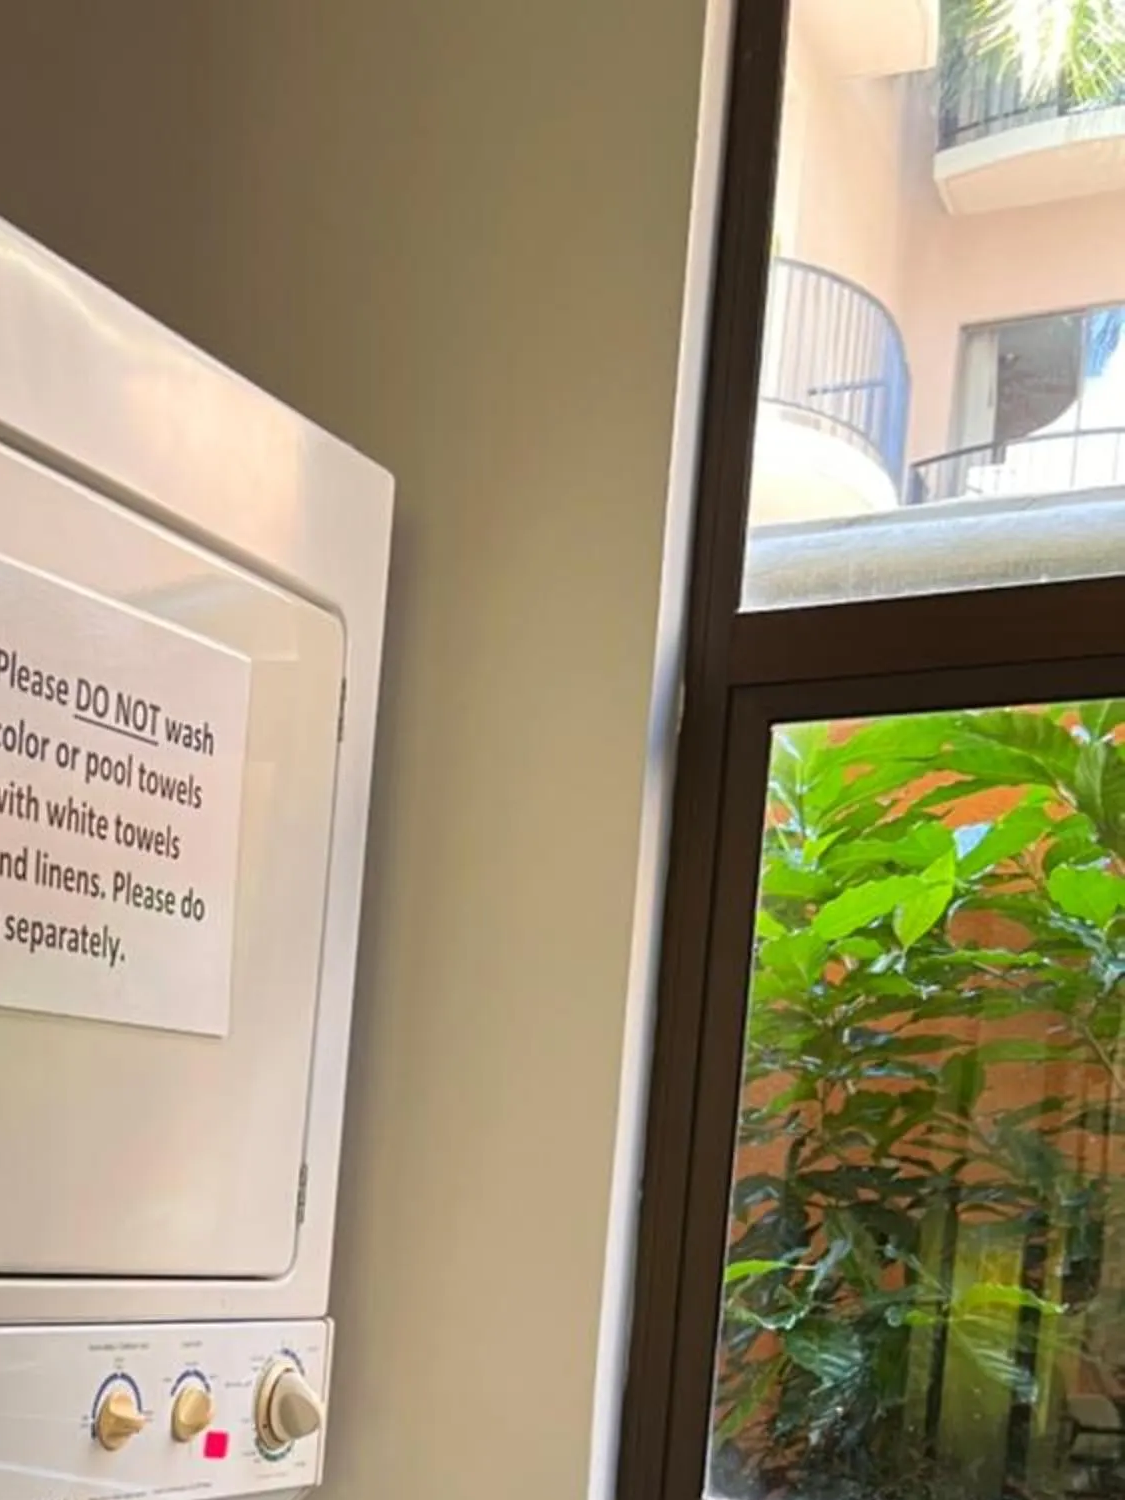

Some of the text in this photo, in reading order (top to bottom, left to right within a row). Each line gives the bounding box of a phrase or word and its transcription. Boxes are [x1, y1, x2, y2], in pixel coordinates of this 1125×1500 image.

[75, 677, 110, 719] DO
[114, 691, 161, 737] NOT
[165, 716, 214, 757] wash
[56, 741, 80, 770] or
[84, 750, 133, 789] pool
[138, 761, 203, 809] towels
[46, 796, 109, 841] white
[115, 813, 181, 861] towels
[34, 848, 106, 900] linens.
[112, 869, 176, 916] Please
[181, 887, 206, 922] do
[4, 914, 126, 968] separately.
